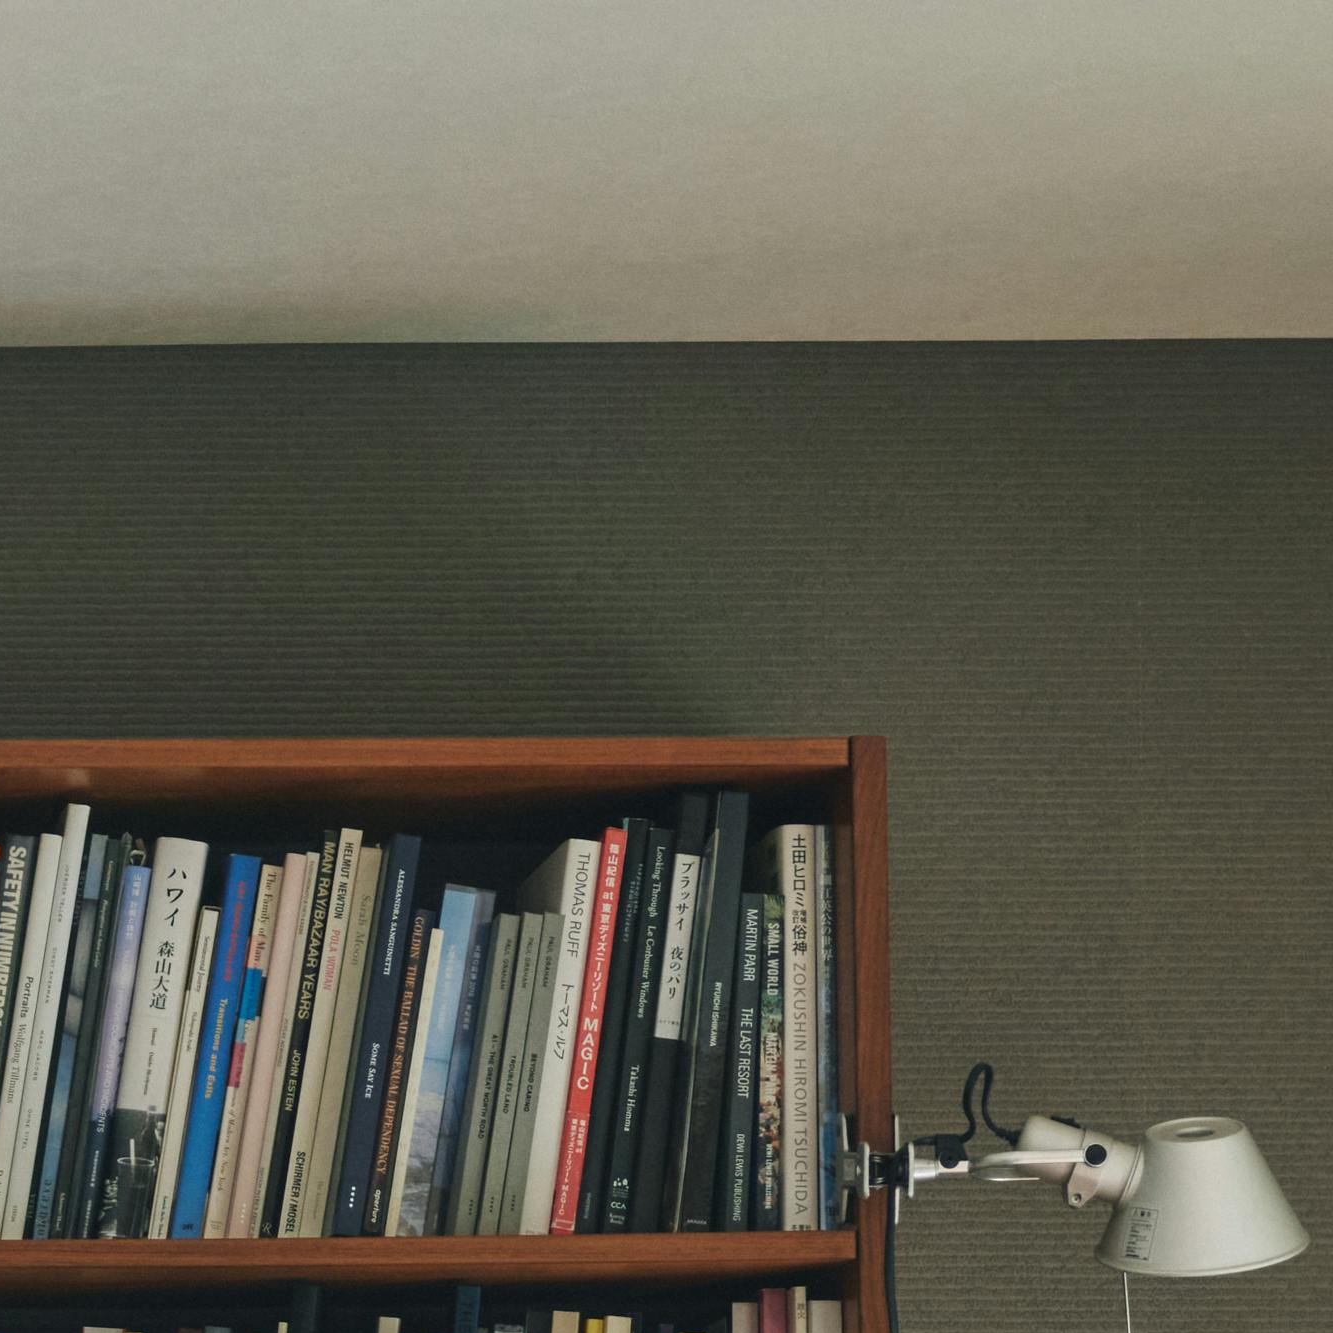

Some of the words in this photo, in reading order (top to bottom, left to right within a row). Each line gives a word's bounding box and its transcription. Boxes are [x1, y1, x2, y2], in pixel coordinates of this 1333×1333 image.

[1, 846, 27, 907] SAFETY
[338, 842, 355, 879] HELMUT
[334, 882, 349, 919] NEWTON
[389, 869, 406, 920] ALESSANDRA
[571, 852, 592, 916] THOMAS
[566, 920, 584, 958] RUFF
[744, 908, 758, 949] MARTIN
[383, 922, 399, 976] SANGUINETTI
[742, 953, 756, 982] PARR
[741, 1007, 753, 1027] THE
[793, 962, 807, 1052] ZOKUSHIN
[289, 1049, 302, 1076] JOHN
[369, 1042, 381, 1065] SOME
[739, 1032, 752, 1056] LAST
[365, 1084, 375, 1099] ICE
[367, 1068, 378, 1082] SAY
[736, 1059, 751, 1098] RESORT
[793, 1059, 807, 1123] HIROMI
[284, 1079, 298, 1111] ESTEN
[794, 1128, 808, 1215] TSUCHIDA
